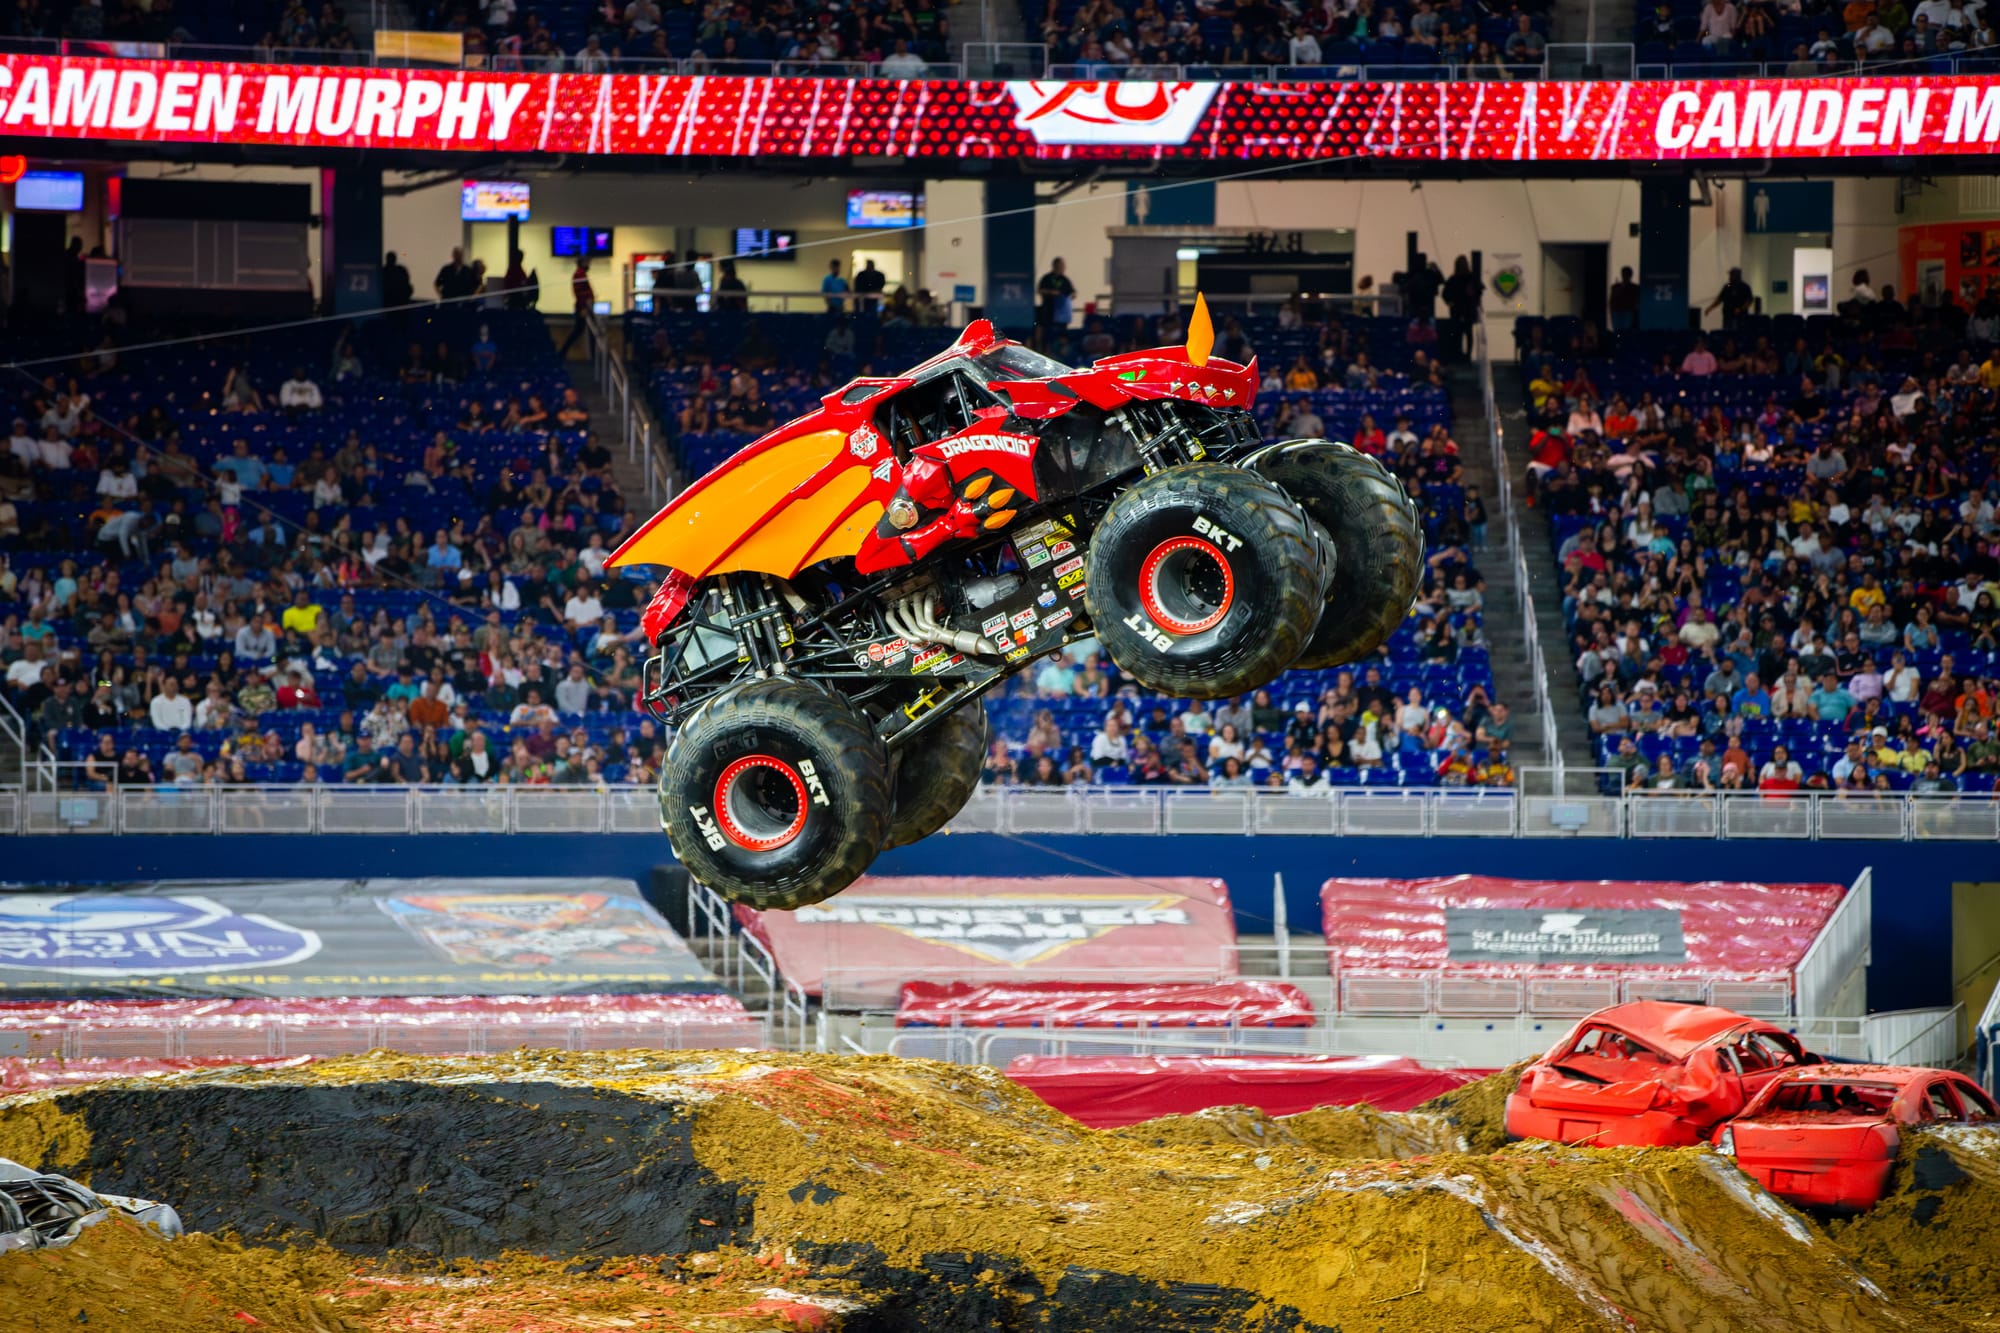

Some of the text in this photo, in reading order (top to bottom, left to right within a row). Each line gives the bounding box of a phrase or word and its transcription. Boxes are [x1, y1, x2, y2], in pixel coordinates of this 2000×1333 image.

[0, 65, 530, 140] AMDEN MURPHY
[1655, 87, 1930, 149] CAMDEN
[936, 434, 1031, 457] DRAGONOID
[1191, 515, 1243, 553] BKT
[885, 638, 908, 654] MSD
[1122, 613, 1175, 653] BKT
[914, 645, 944, 665] ARP
[797, 759, 830, 807] BKT
[689, 804, 727, 852] BKT
[795, 905, 1188, 925] MONSTER
